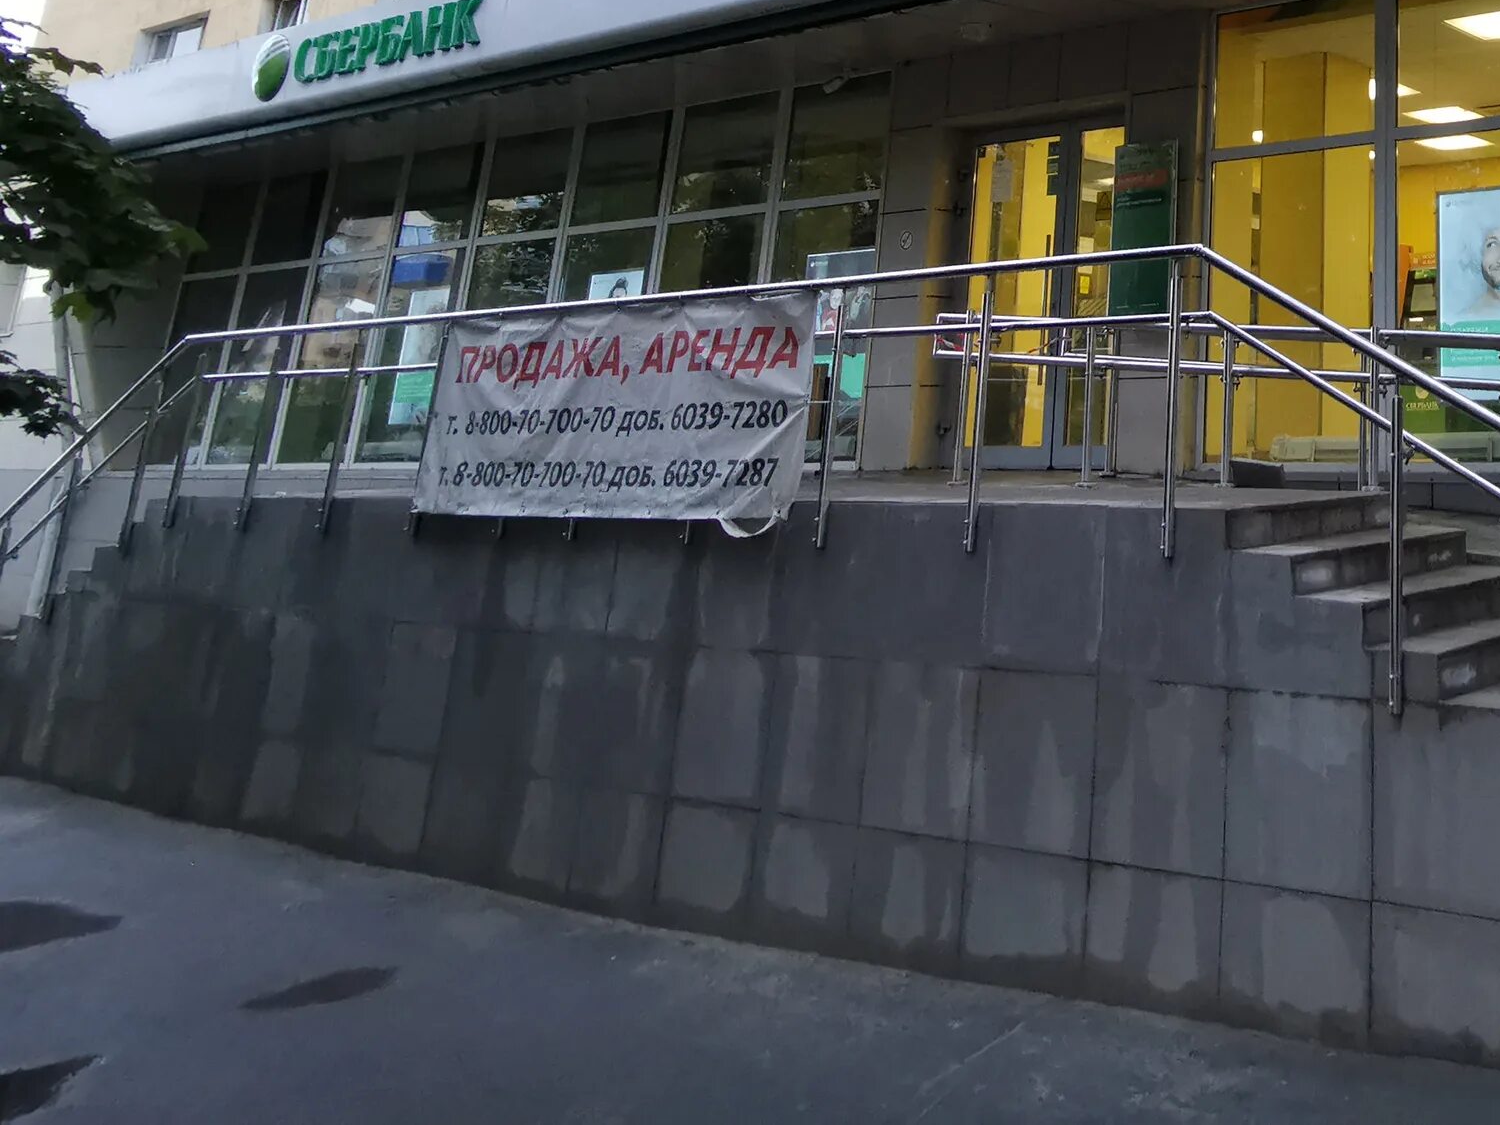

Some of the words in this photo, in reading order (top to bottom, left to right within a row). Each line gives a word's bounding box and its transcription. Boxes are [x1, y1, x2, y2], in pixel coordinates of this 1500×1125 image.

[455, 335, 630, 390] ПРОДАЖА,
[639, 326, 800, 379] АРЕНДА
[465, 406, 616, 435] 8-800-70-700-70
[671, 399, 789, 431] 6039-7280
[452, 460, 607, 488] 8-800-70-700-70
[663, 457, 779, 488] 6039-7287
